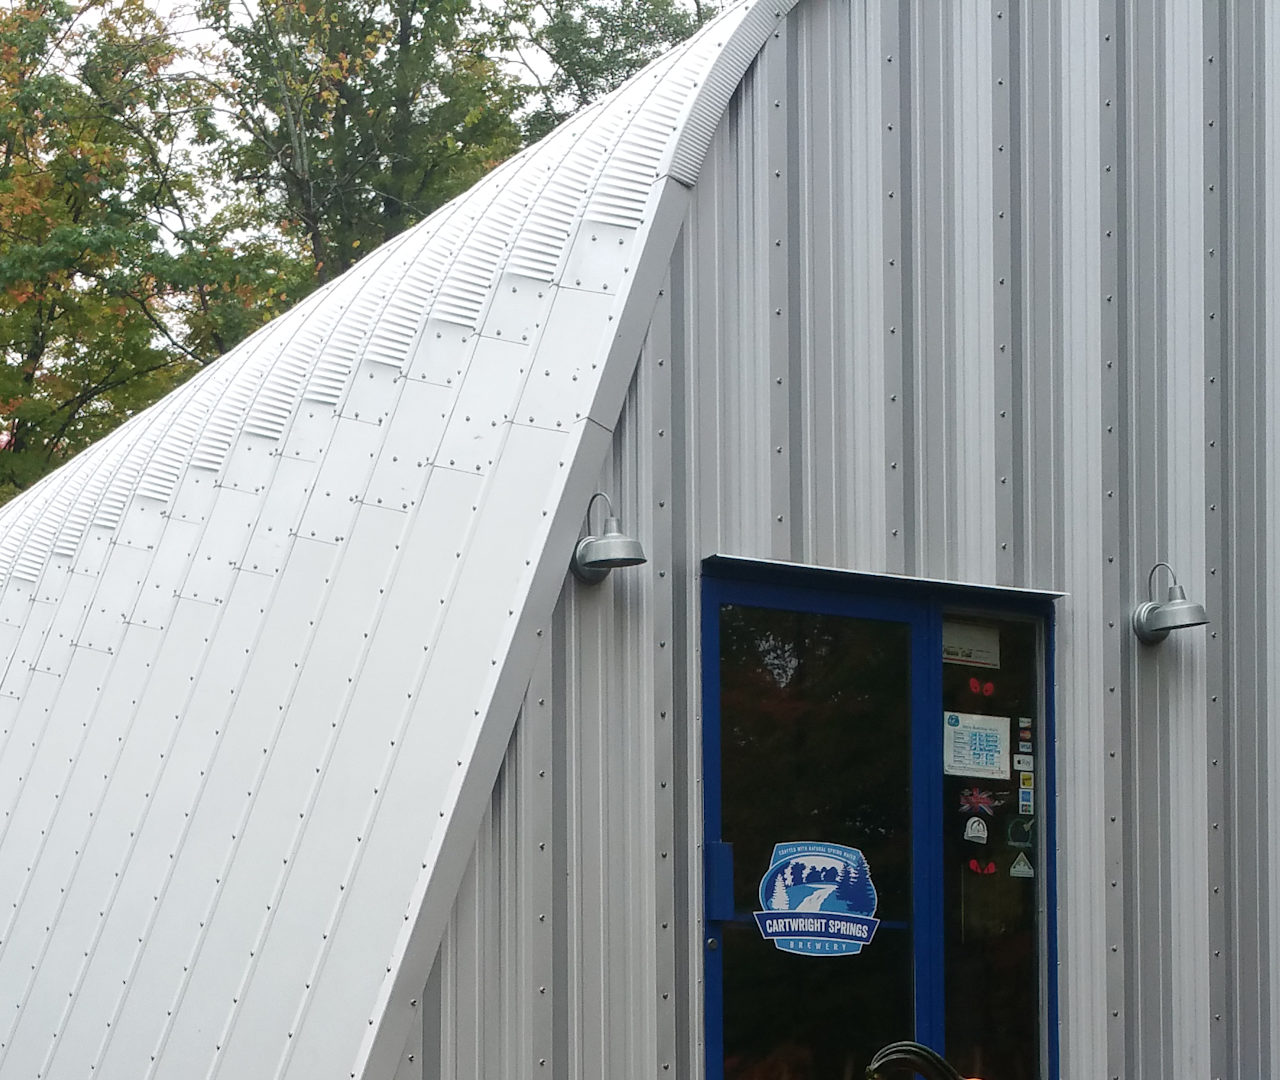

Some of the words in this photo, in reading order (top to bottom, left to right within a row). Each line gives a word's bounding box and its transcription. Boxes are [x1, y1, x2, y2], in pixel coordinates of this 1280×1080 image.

[765, 919, 827, 934] CARTWRIGHT
[828, 920, 869, 939] SPRINGS
[789, 942, 848, 951] BREWERY
